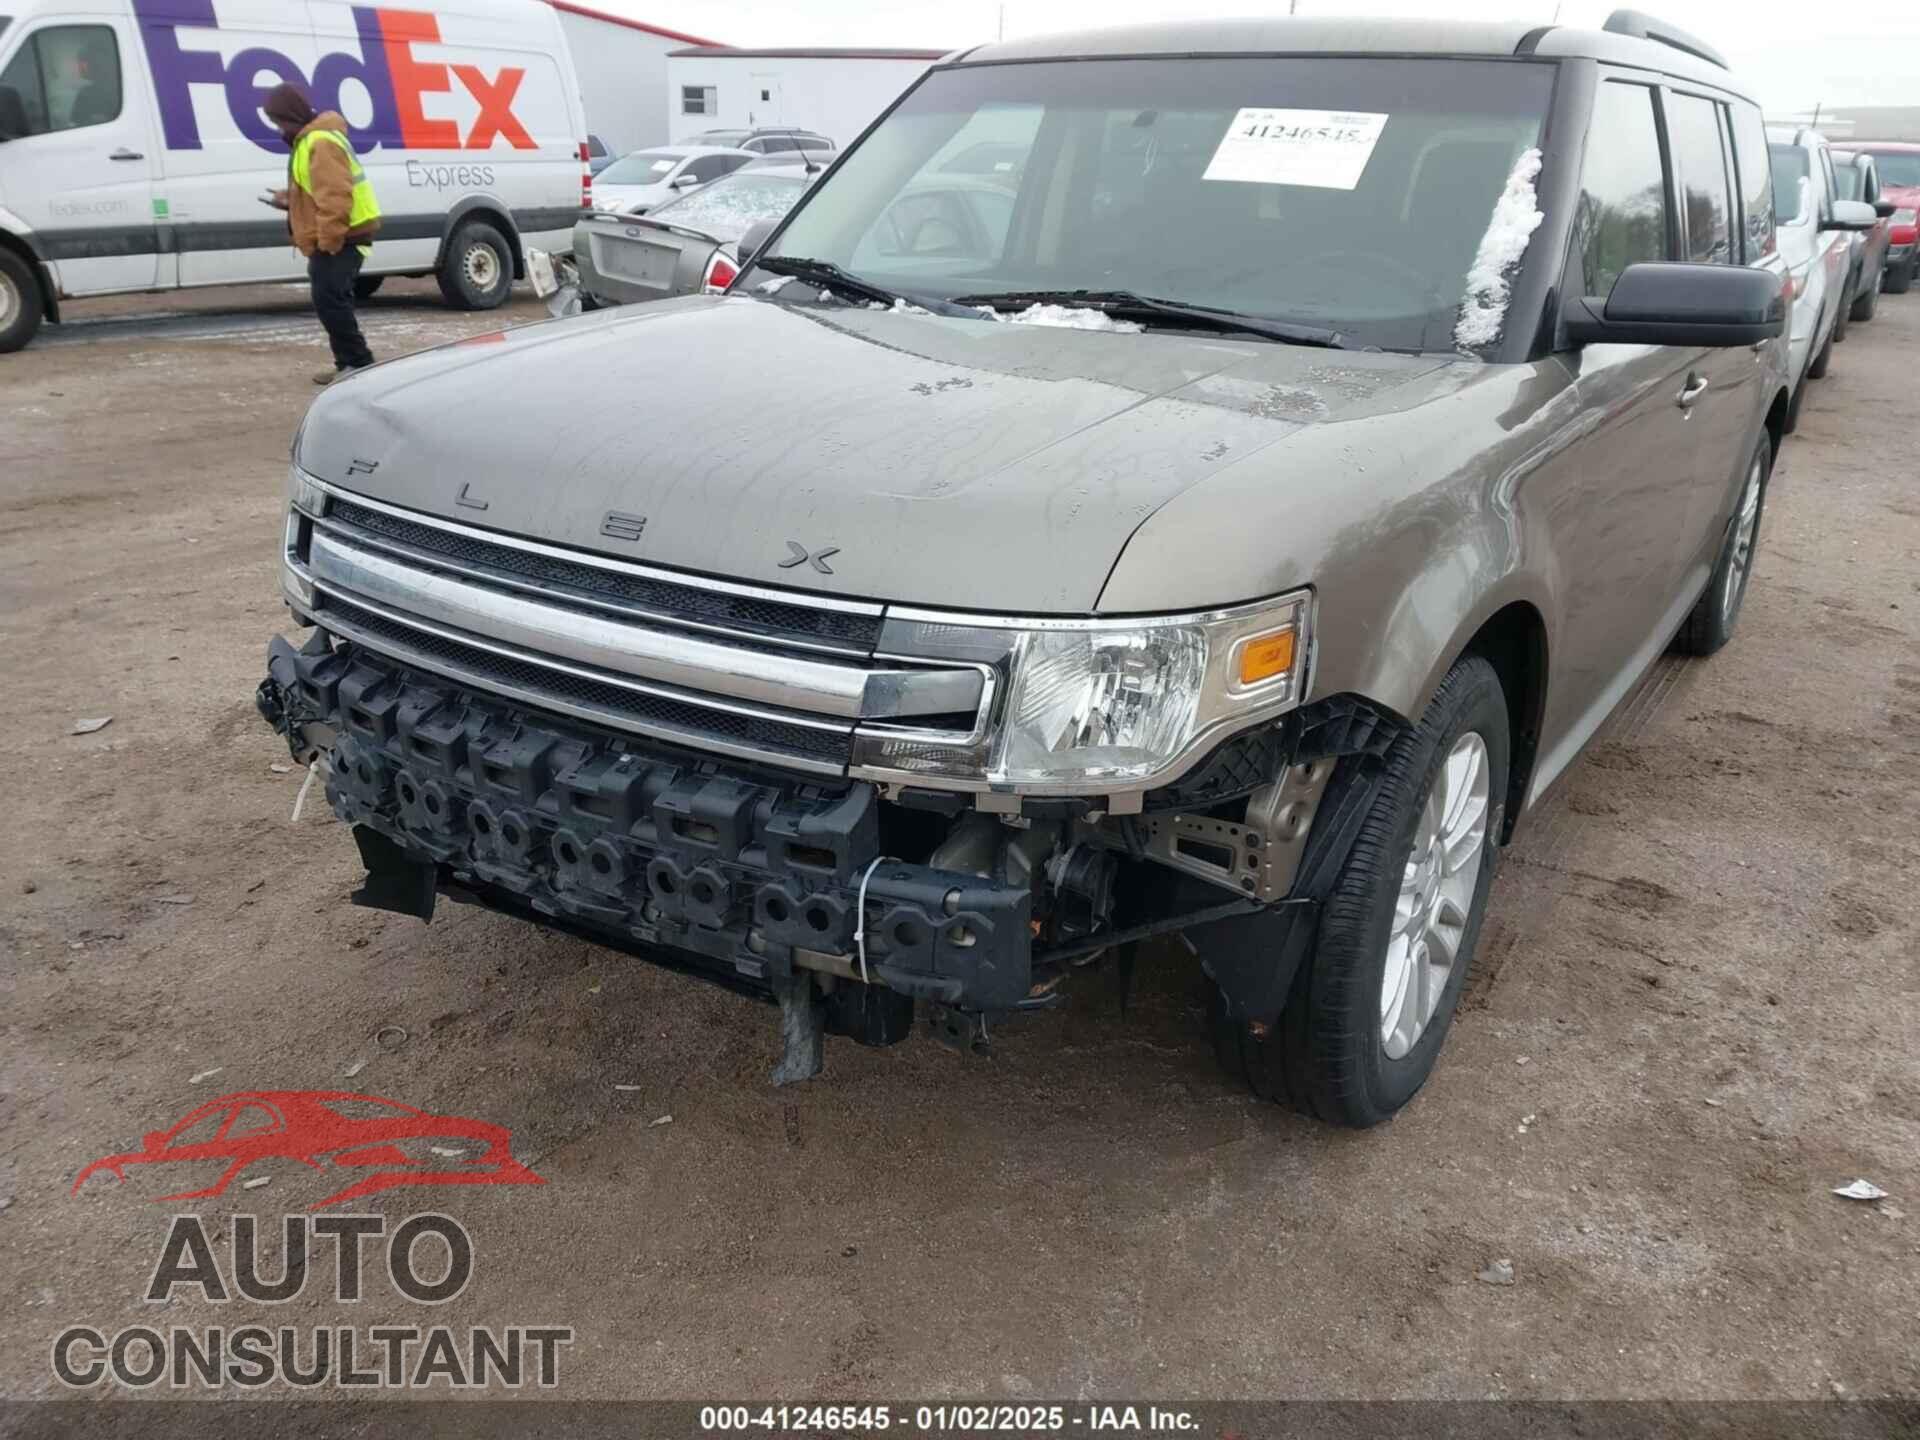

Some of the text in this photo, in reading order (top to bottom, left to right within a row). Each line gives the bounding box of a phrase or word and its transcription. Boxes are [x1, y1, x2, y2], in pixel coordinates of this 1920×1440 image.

[132, 0, 539, 154] FedEx
[406, 160, 495, 192] Express
[345, 459, 842, 574] FLEX
